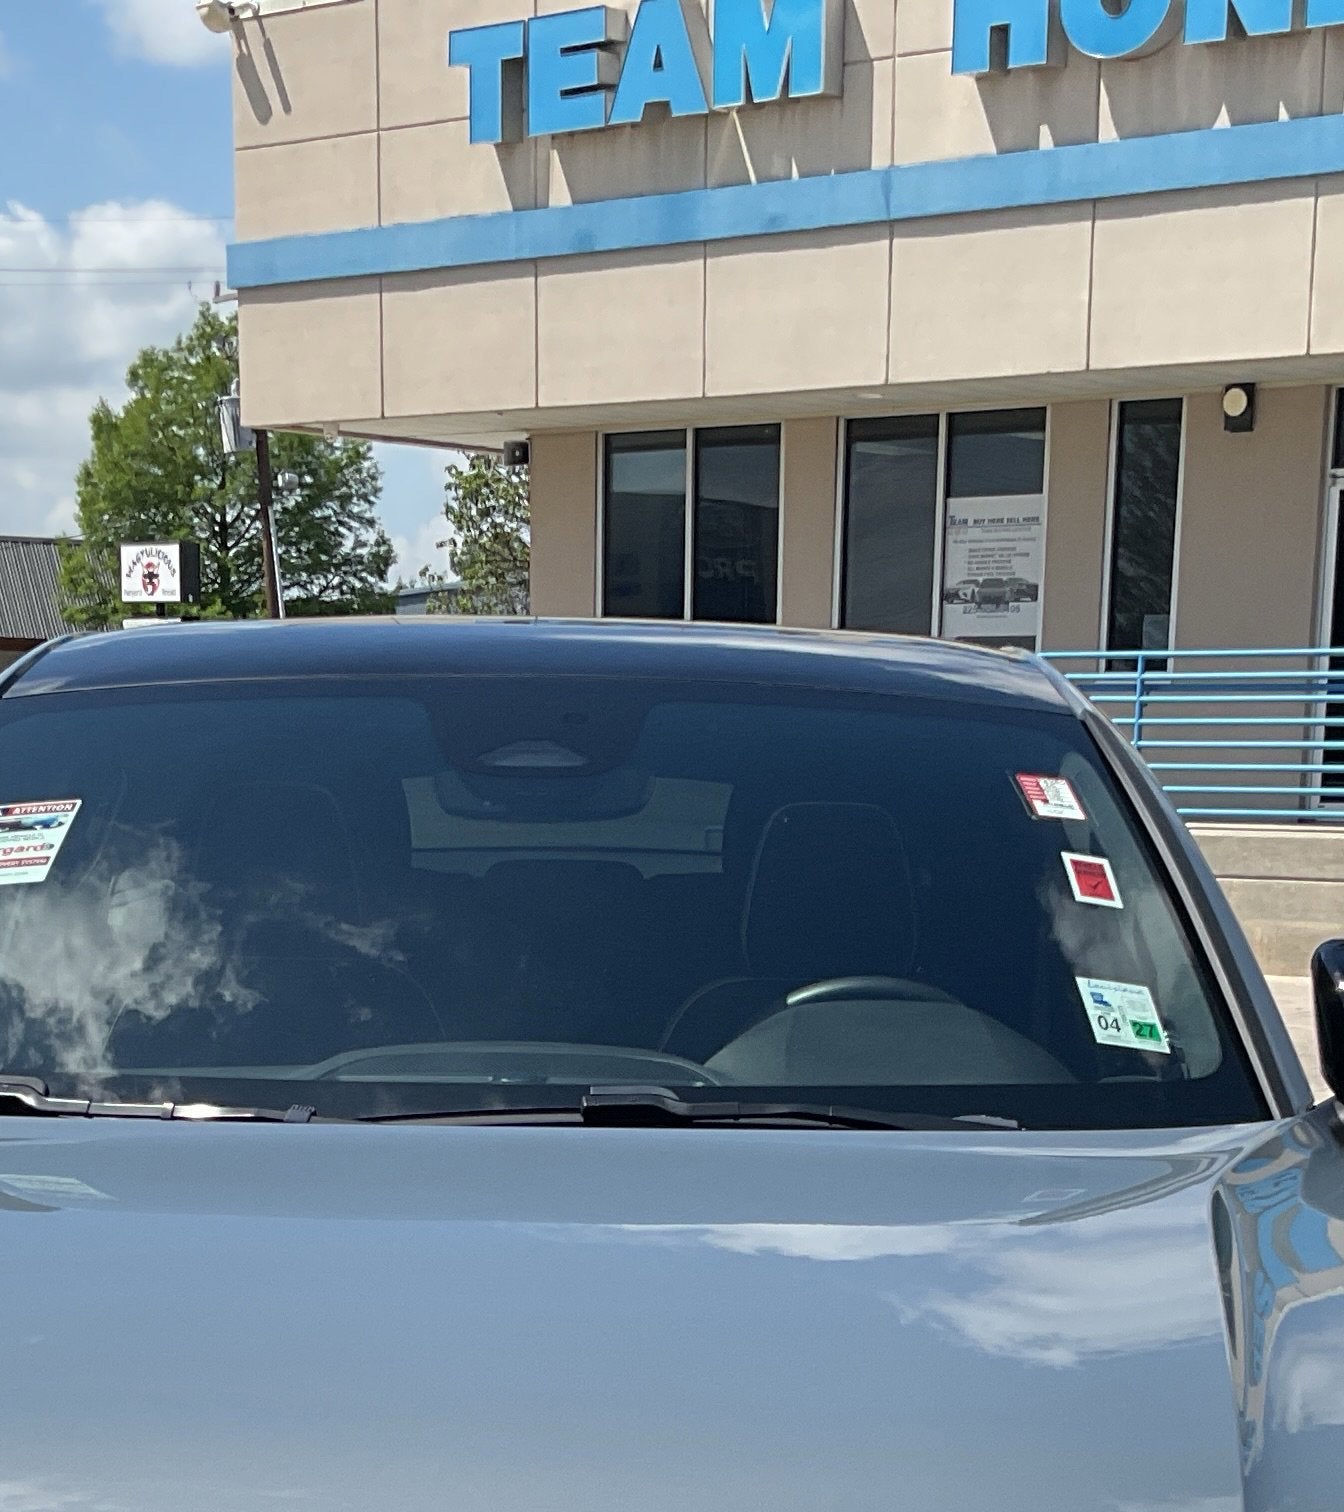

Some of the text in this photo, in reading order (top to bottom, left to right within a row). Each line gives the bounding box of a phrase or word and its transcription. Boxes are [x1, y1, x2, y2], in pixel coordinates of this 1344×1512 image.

[448, 0, 829, 144] TEAM
[12, 803, 73, 815] ATTENTION
[1097, 1015, 1121, 1033] 04
[1131, 1022, 1155, 1038] 27
